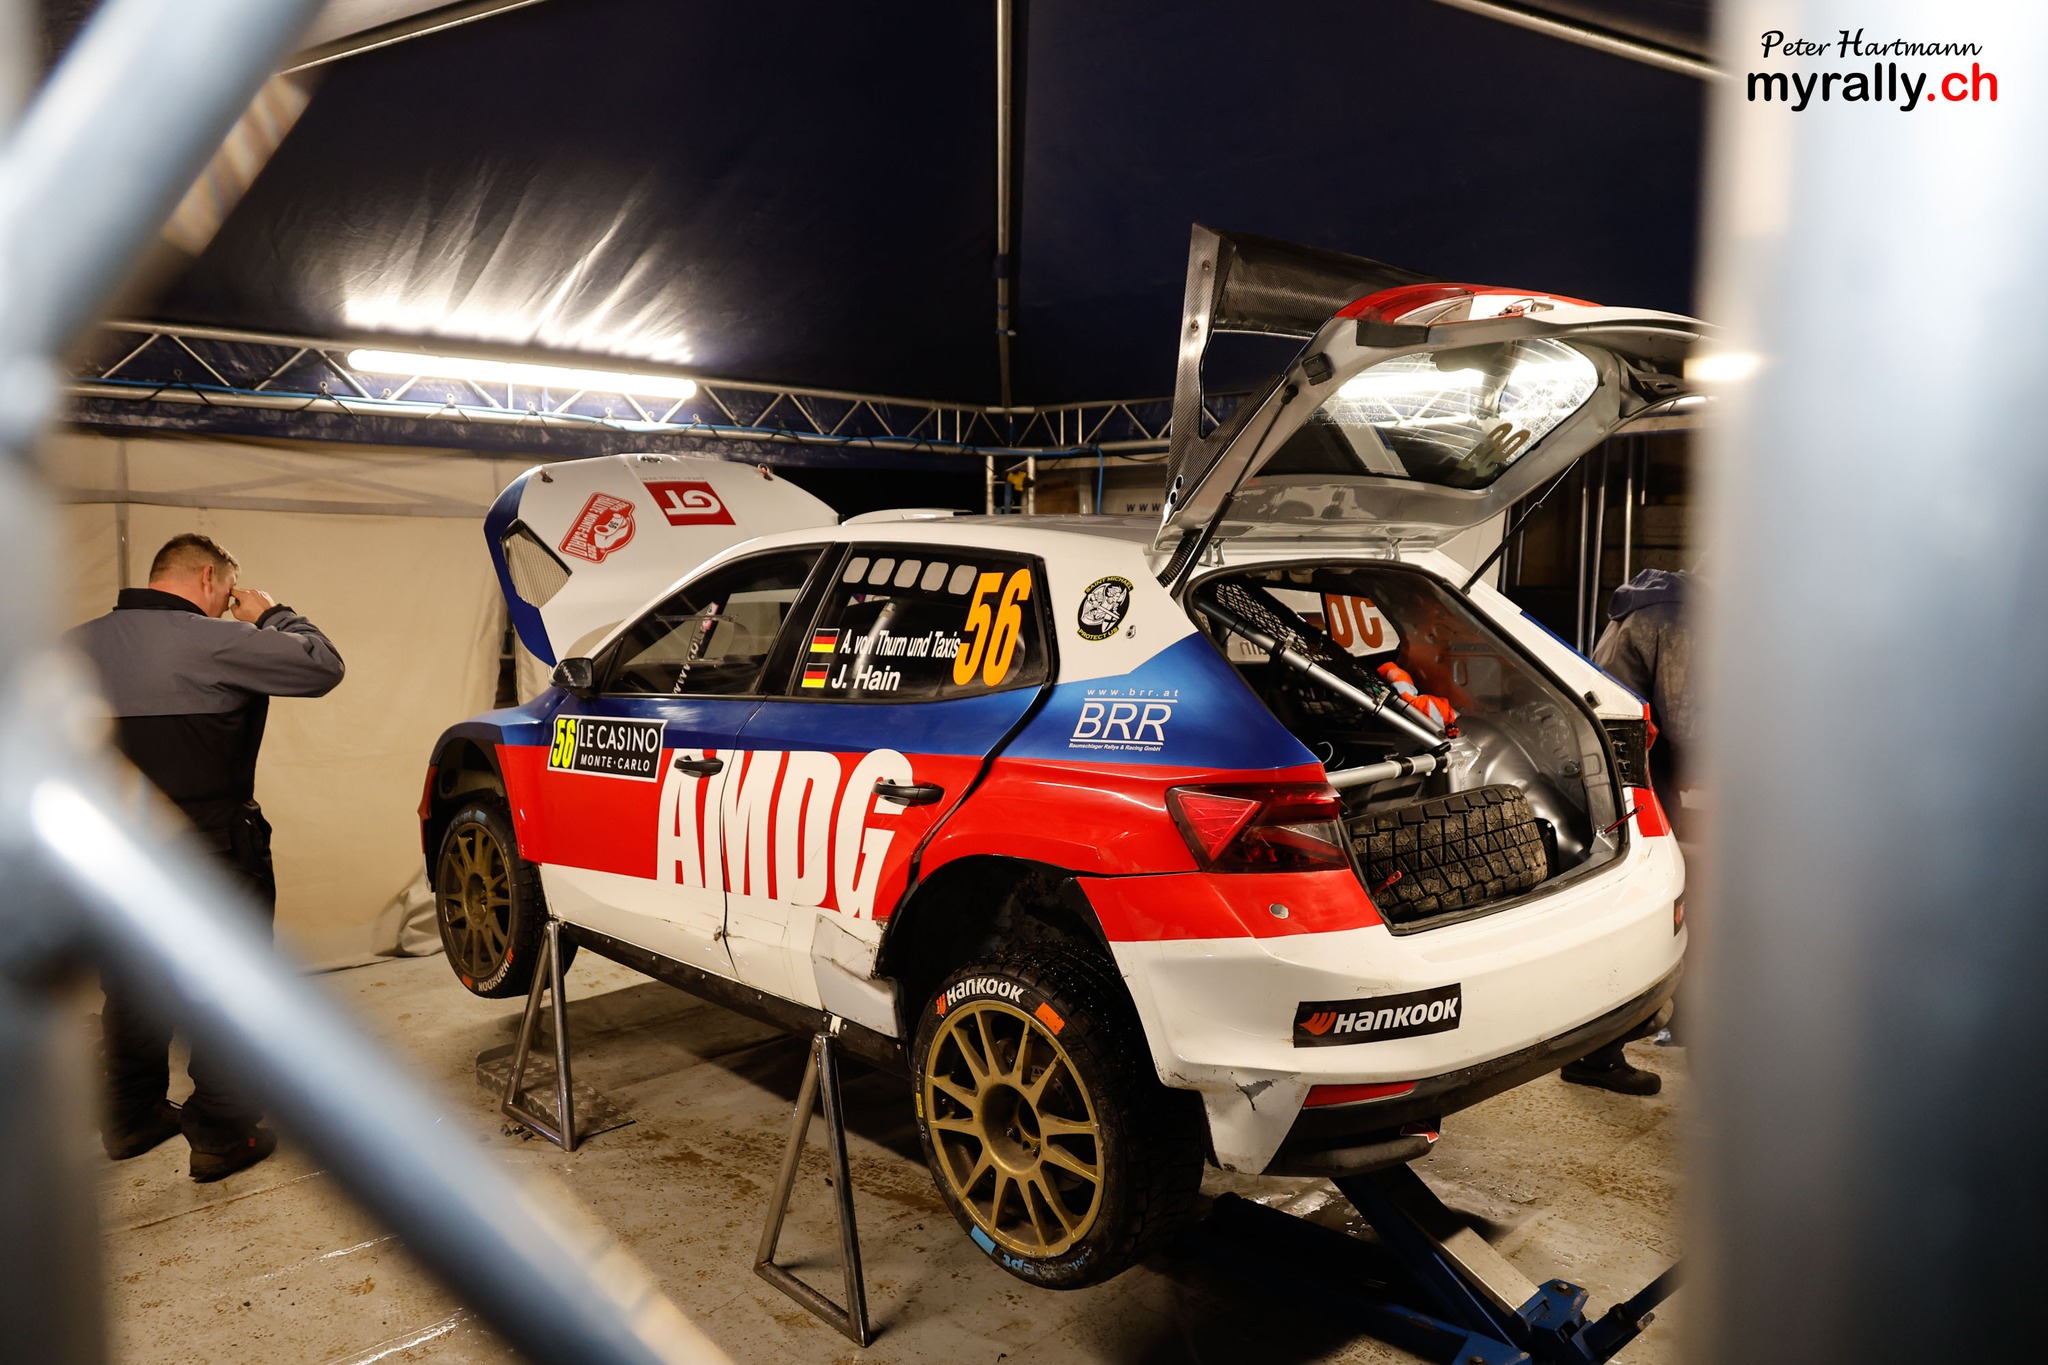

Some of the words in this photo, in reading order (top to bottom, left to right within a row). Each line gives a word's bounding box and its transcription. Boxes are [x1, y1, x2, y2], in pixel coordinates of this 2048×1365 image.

[1085, 578, 1106, 593] SAINT
[1107, 576, 1133, 590] MICHAEL
[953, 568, 1032, 687] 56
[1079, 628, 1107, 640] PROTECT
[1108, 627, 1119, 636] US
[839, 628, 852, 654] A.
[854, 634, 874, 656] von
[875, 630, 908, 656] Thurn
[907, 631, 933, 658] und
[931, 631, 961, 659] Taxis
[831, 664, 847, 689] J.
[853, 664, 901, 691] Hain
[1072, 703, 1172, 741] BRR
[551, 718, 576, 769] 56
[579, 724, 595, 748] LE
[596, 725, 659, 754] CASINO
[656, 748, 914, 921] AMDG
